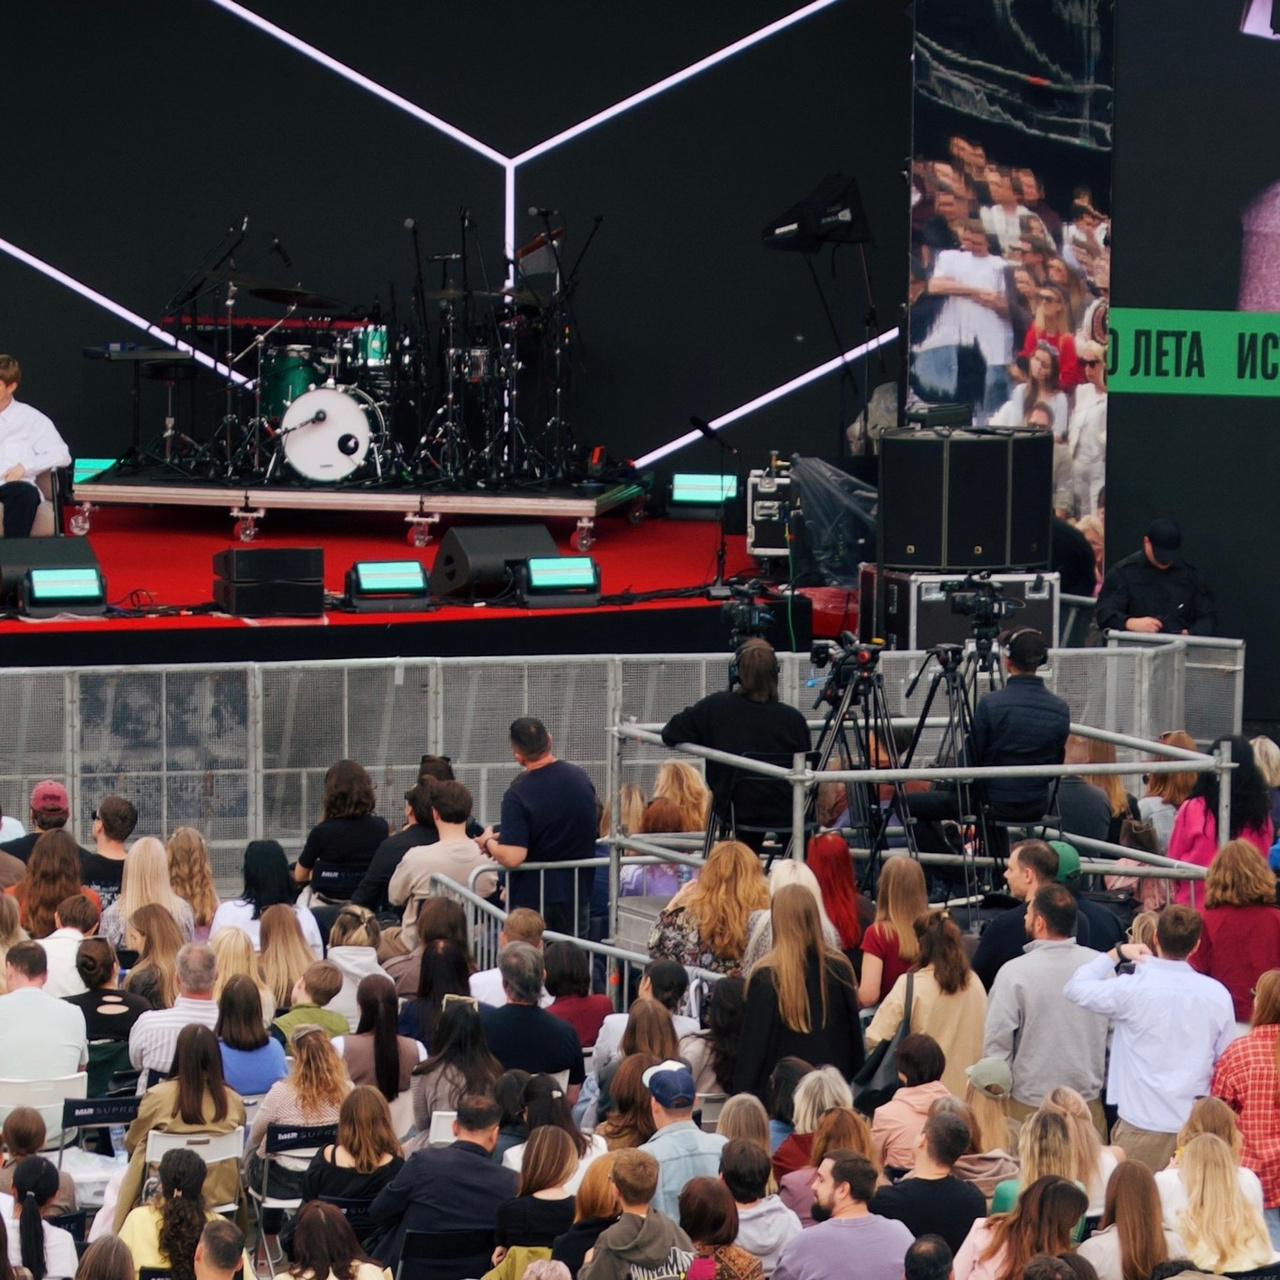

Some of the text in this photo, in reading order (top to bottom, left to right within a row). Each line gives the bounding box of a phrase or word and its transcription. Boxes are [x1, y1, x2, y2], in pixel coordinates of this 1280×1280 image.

[1129, 329, 1206, 378] ЛЕТА
[96, 1106, 134, 1115] SUPRE
[300, 1129, 338, 1138] SUPRE
